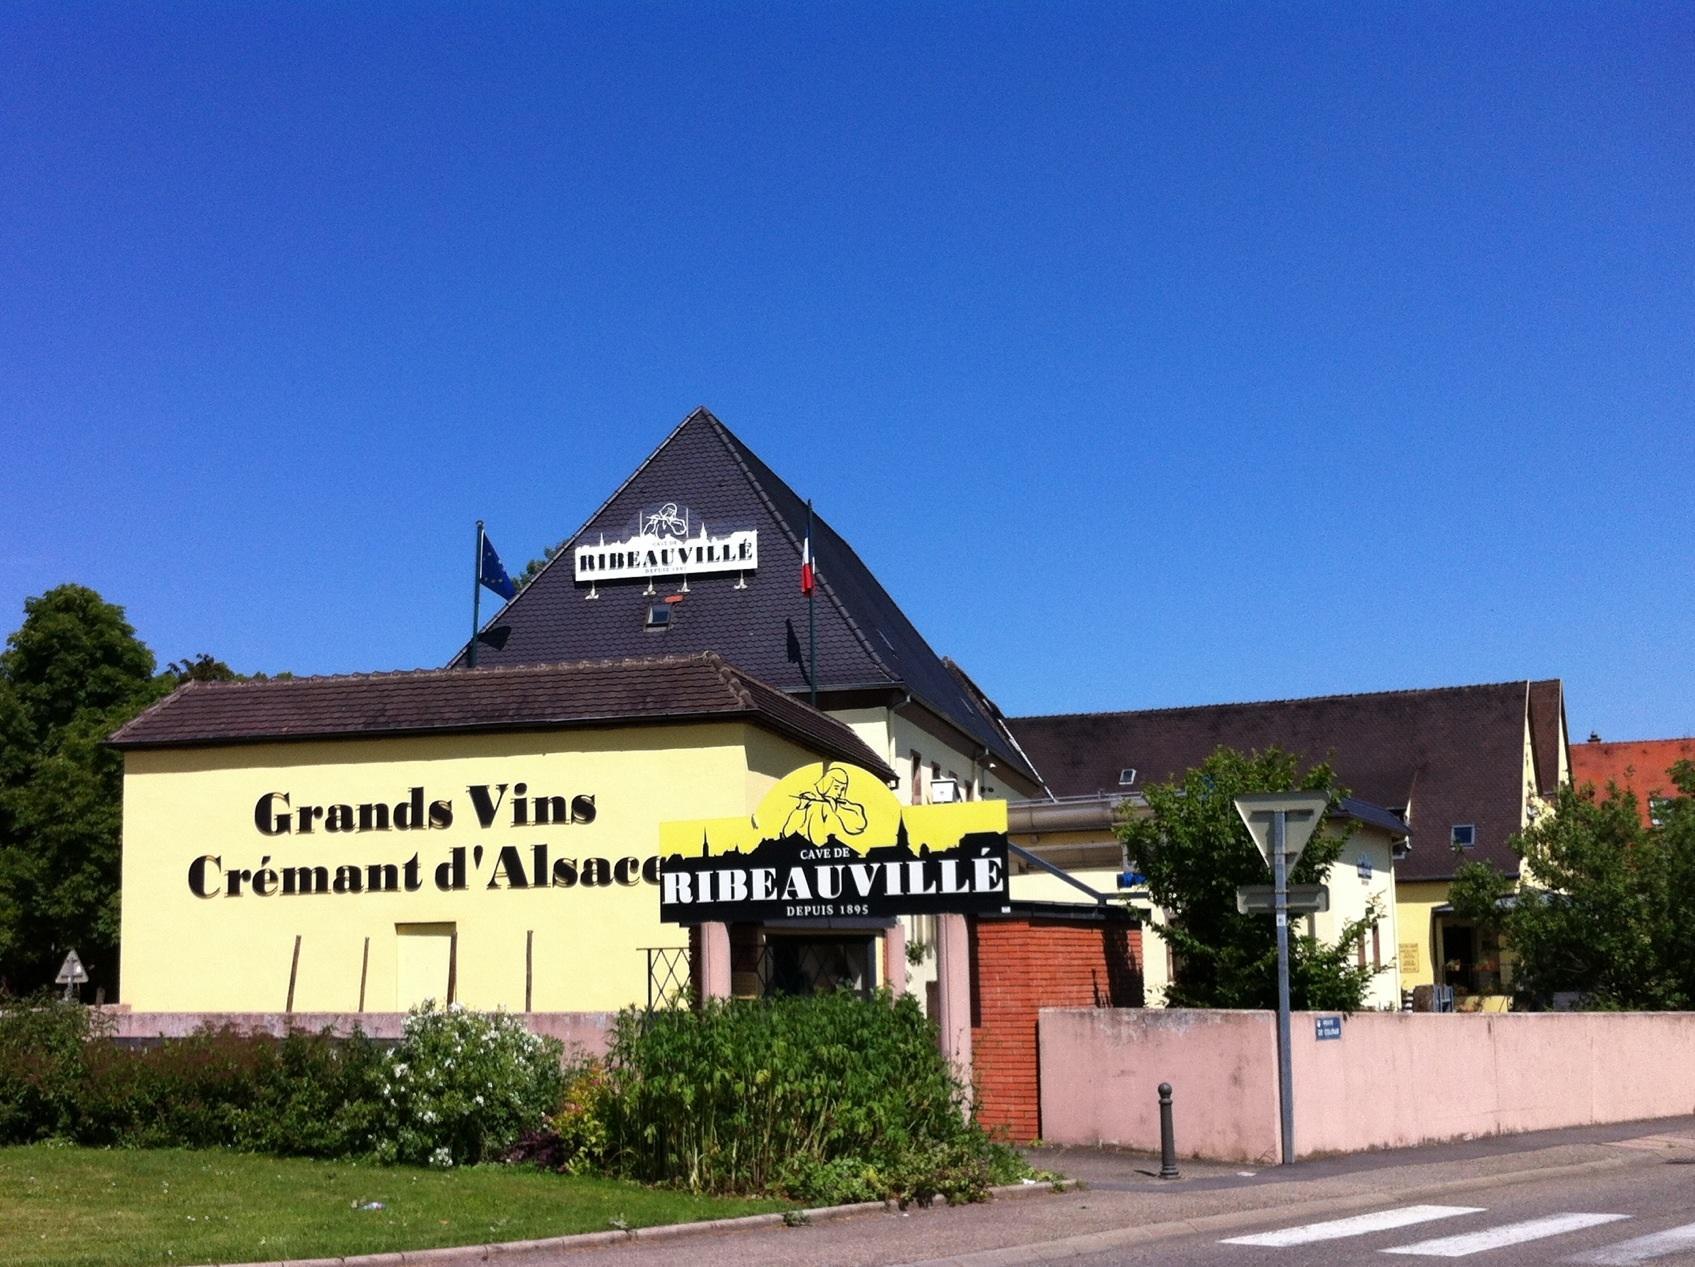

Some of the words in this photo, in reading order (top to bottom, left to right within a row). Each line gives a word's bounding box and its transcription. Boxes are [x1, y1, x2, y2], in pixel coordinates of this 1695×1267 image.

[579, 538, 753, 572] RIBEAUVILLÉ
[253, 786, 455, 837] Grands
[465, 782, 598, 830] Vins
[800, 847, 831, 861] CAVE
[833, 847, 851, 859] DE
[187, 851, 424, 900] Crémant
[661, 847, 1005, 906] RIBEAUVILLÉ
[786, 904, 834, 917] DEPUIS
[839, 904, 870, 916] 1895
